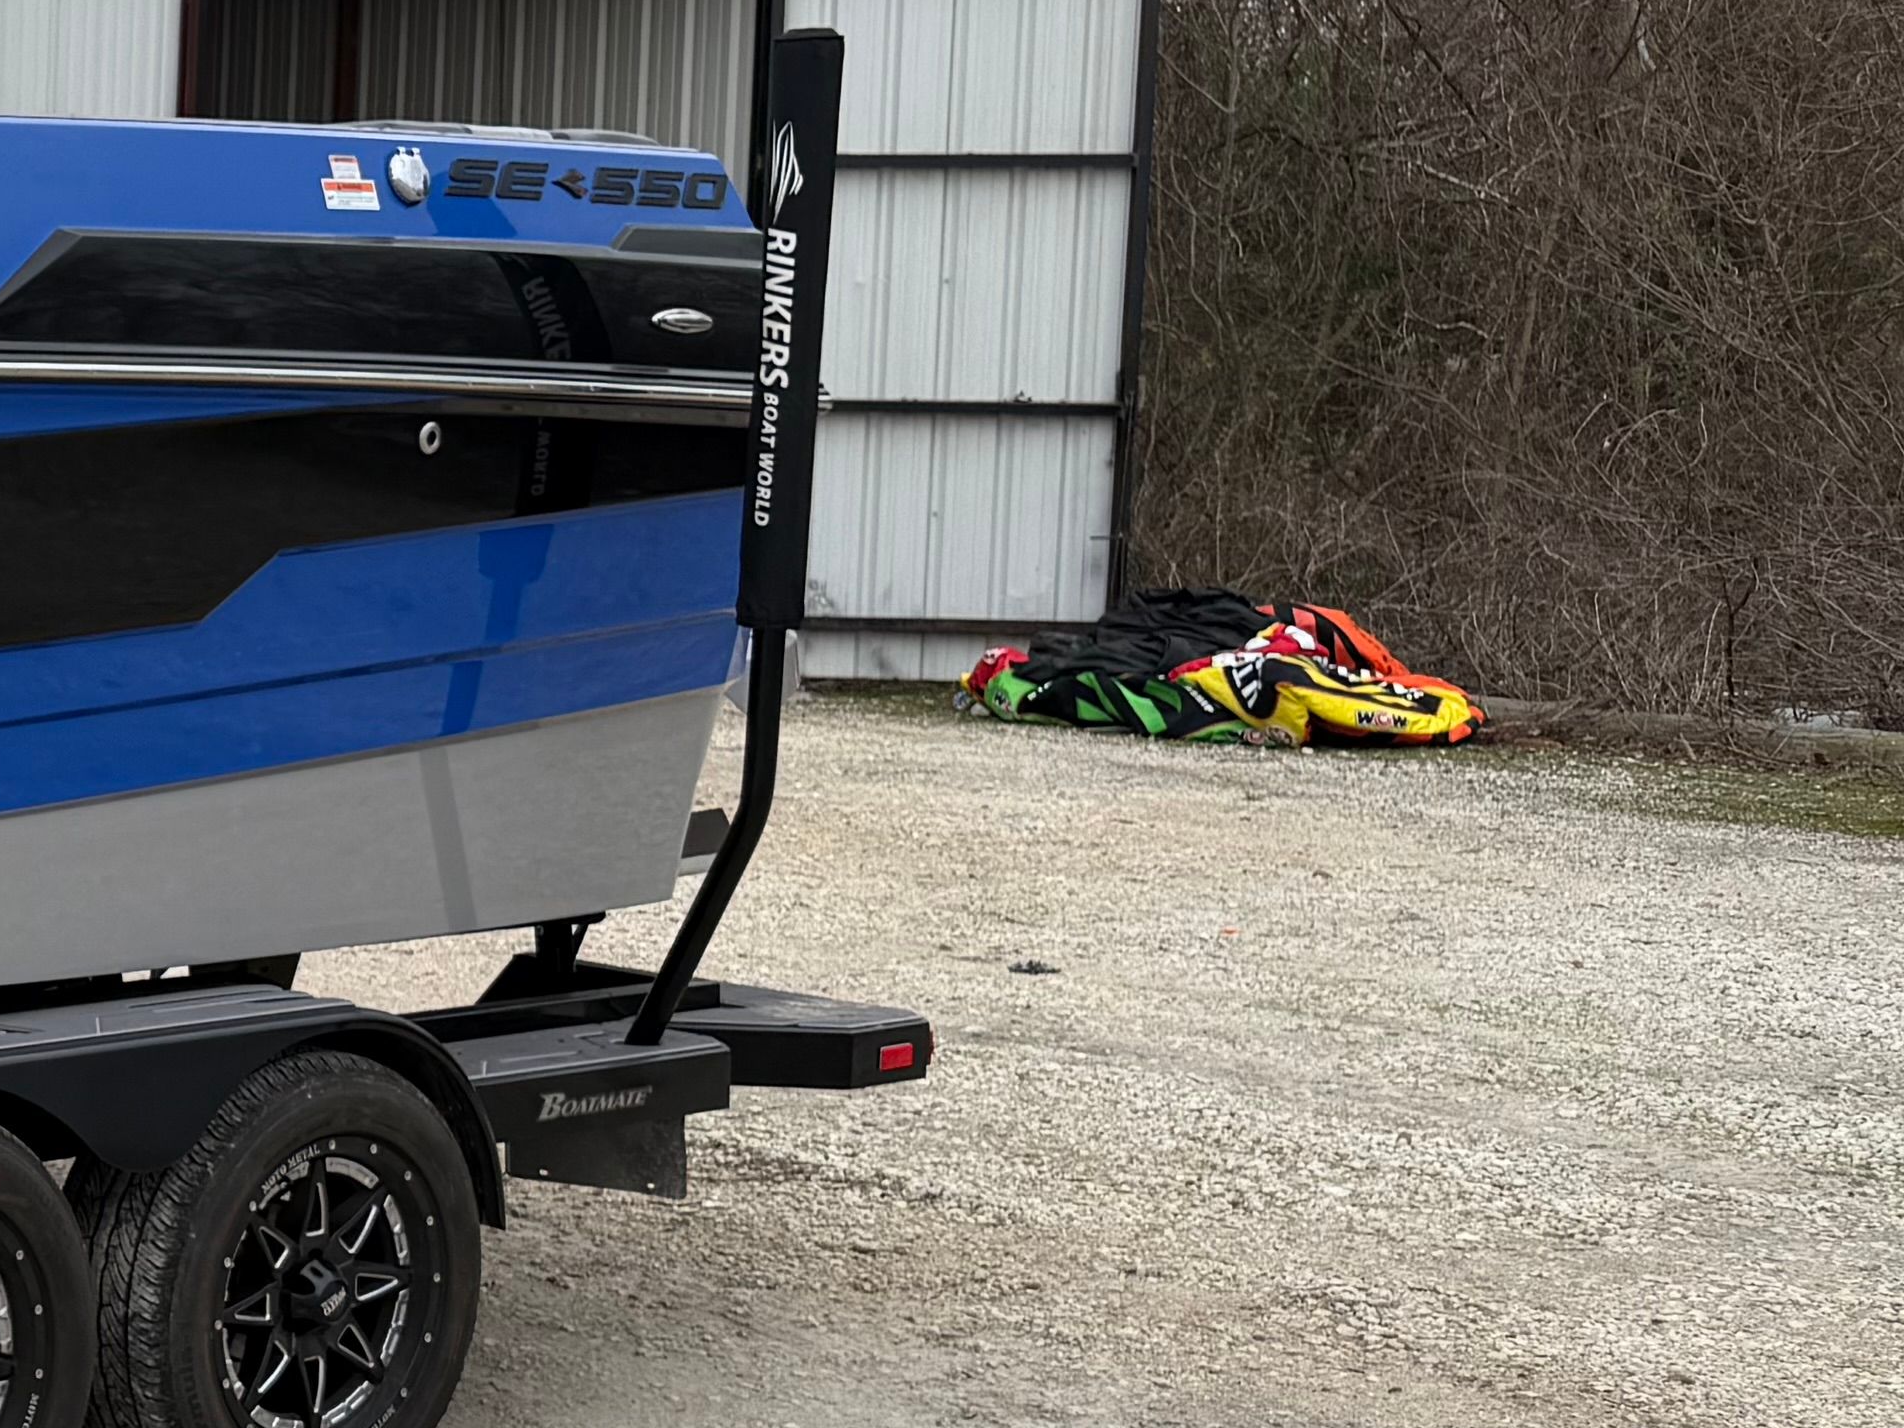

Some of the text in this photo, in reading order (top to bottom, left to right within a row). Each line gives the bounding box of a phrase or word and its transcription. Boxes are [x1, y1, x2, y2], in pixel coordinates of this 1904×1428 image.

[445, 158, 729, 210] SE 550
[754, 227, 798, 527] RINKERS BOAT WORLD
[261, 1144, 320, 1194] MOTO METAL
